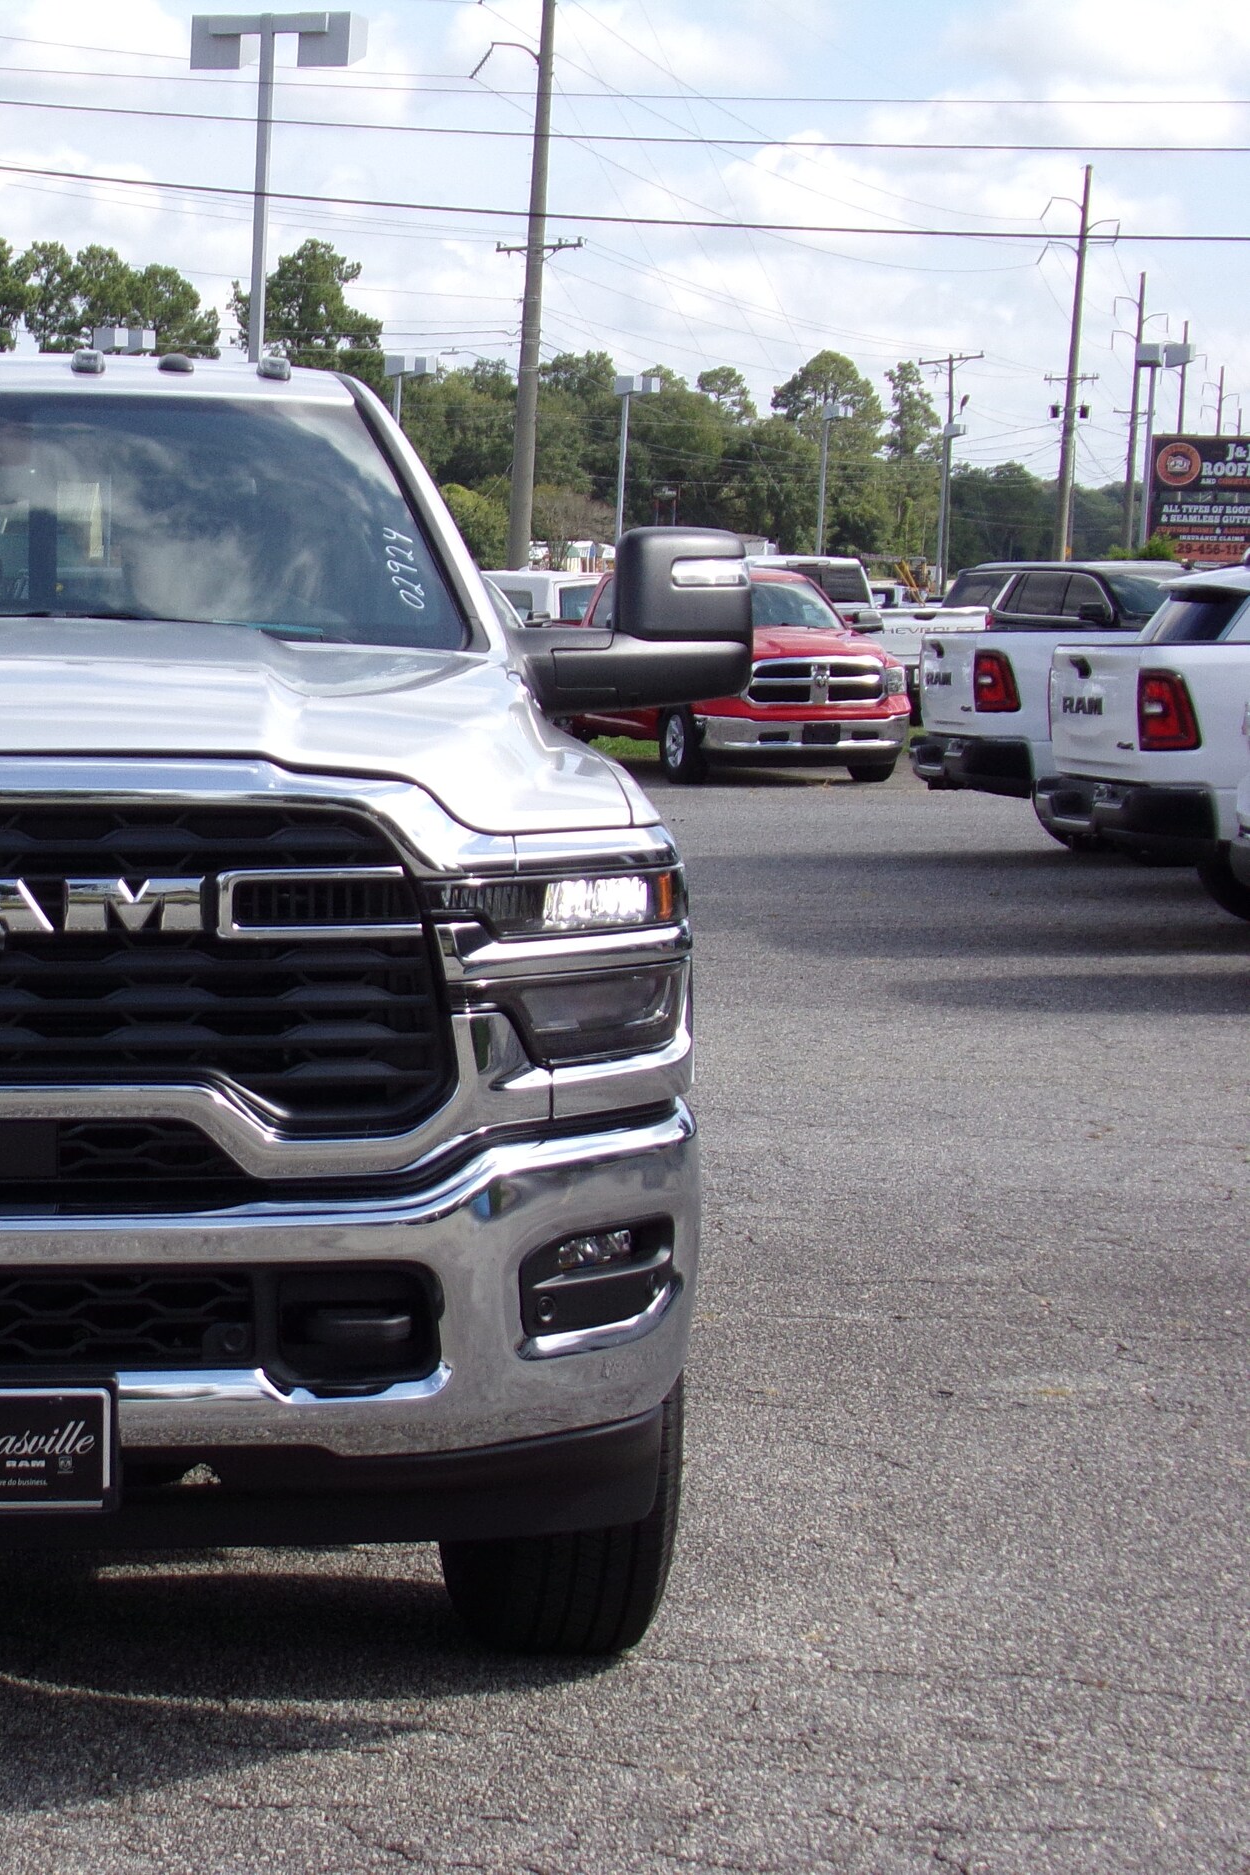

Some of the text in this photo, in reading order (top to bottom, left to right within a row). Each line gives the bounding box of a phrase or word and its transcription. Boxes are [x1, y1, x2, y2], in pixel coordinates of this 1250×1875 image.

[1163, 504, 1180, 513] ALL
[1182, 504, 1210, 514] TYPES
[1211, 505, 1224, 514] OF
[1161, 514, 1169, 522] &
[1170, 514, 1221, 523] SEAMLESS
[383, 526, 425, 609] 02924
[871, 626, 976, 635] HEVROLET
[925, 671, 952, 686] RAM
[1062, 696, 1103, 715] RAM
[5, 1459, 46, 1468] RAM
[7, 1477, 17, 1486] do
[17, 1477, 48, 1486] business.
